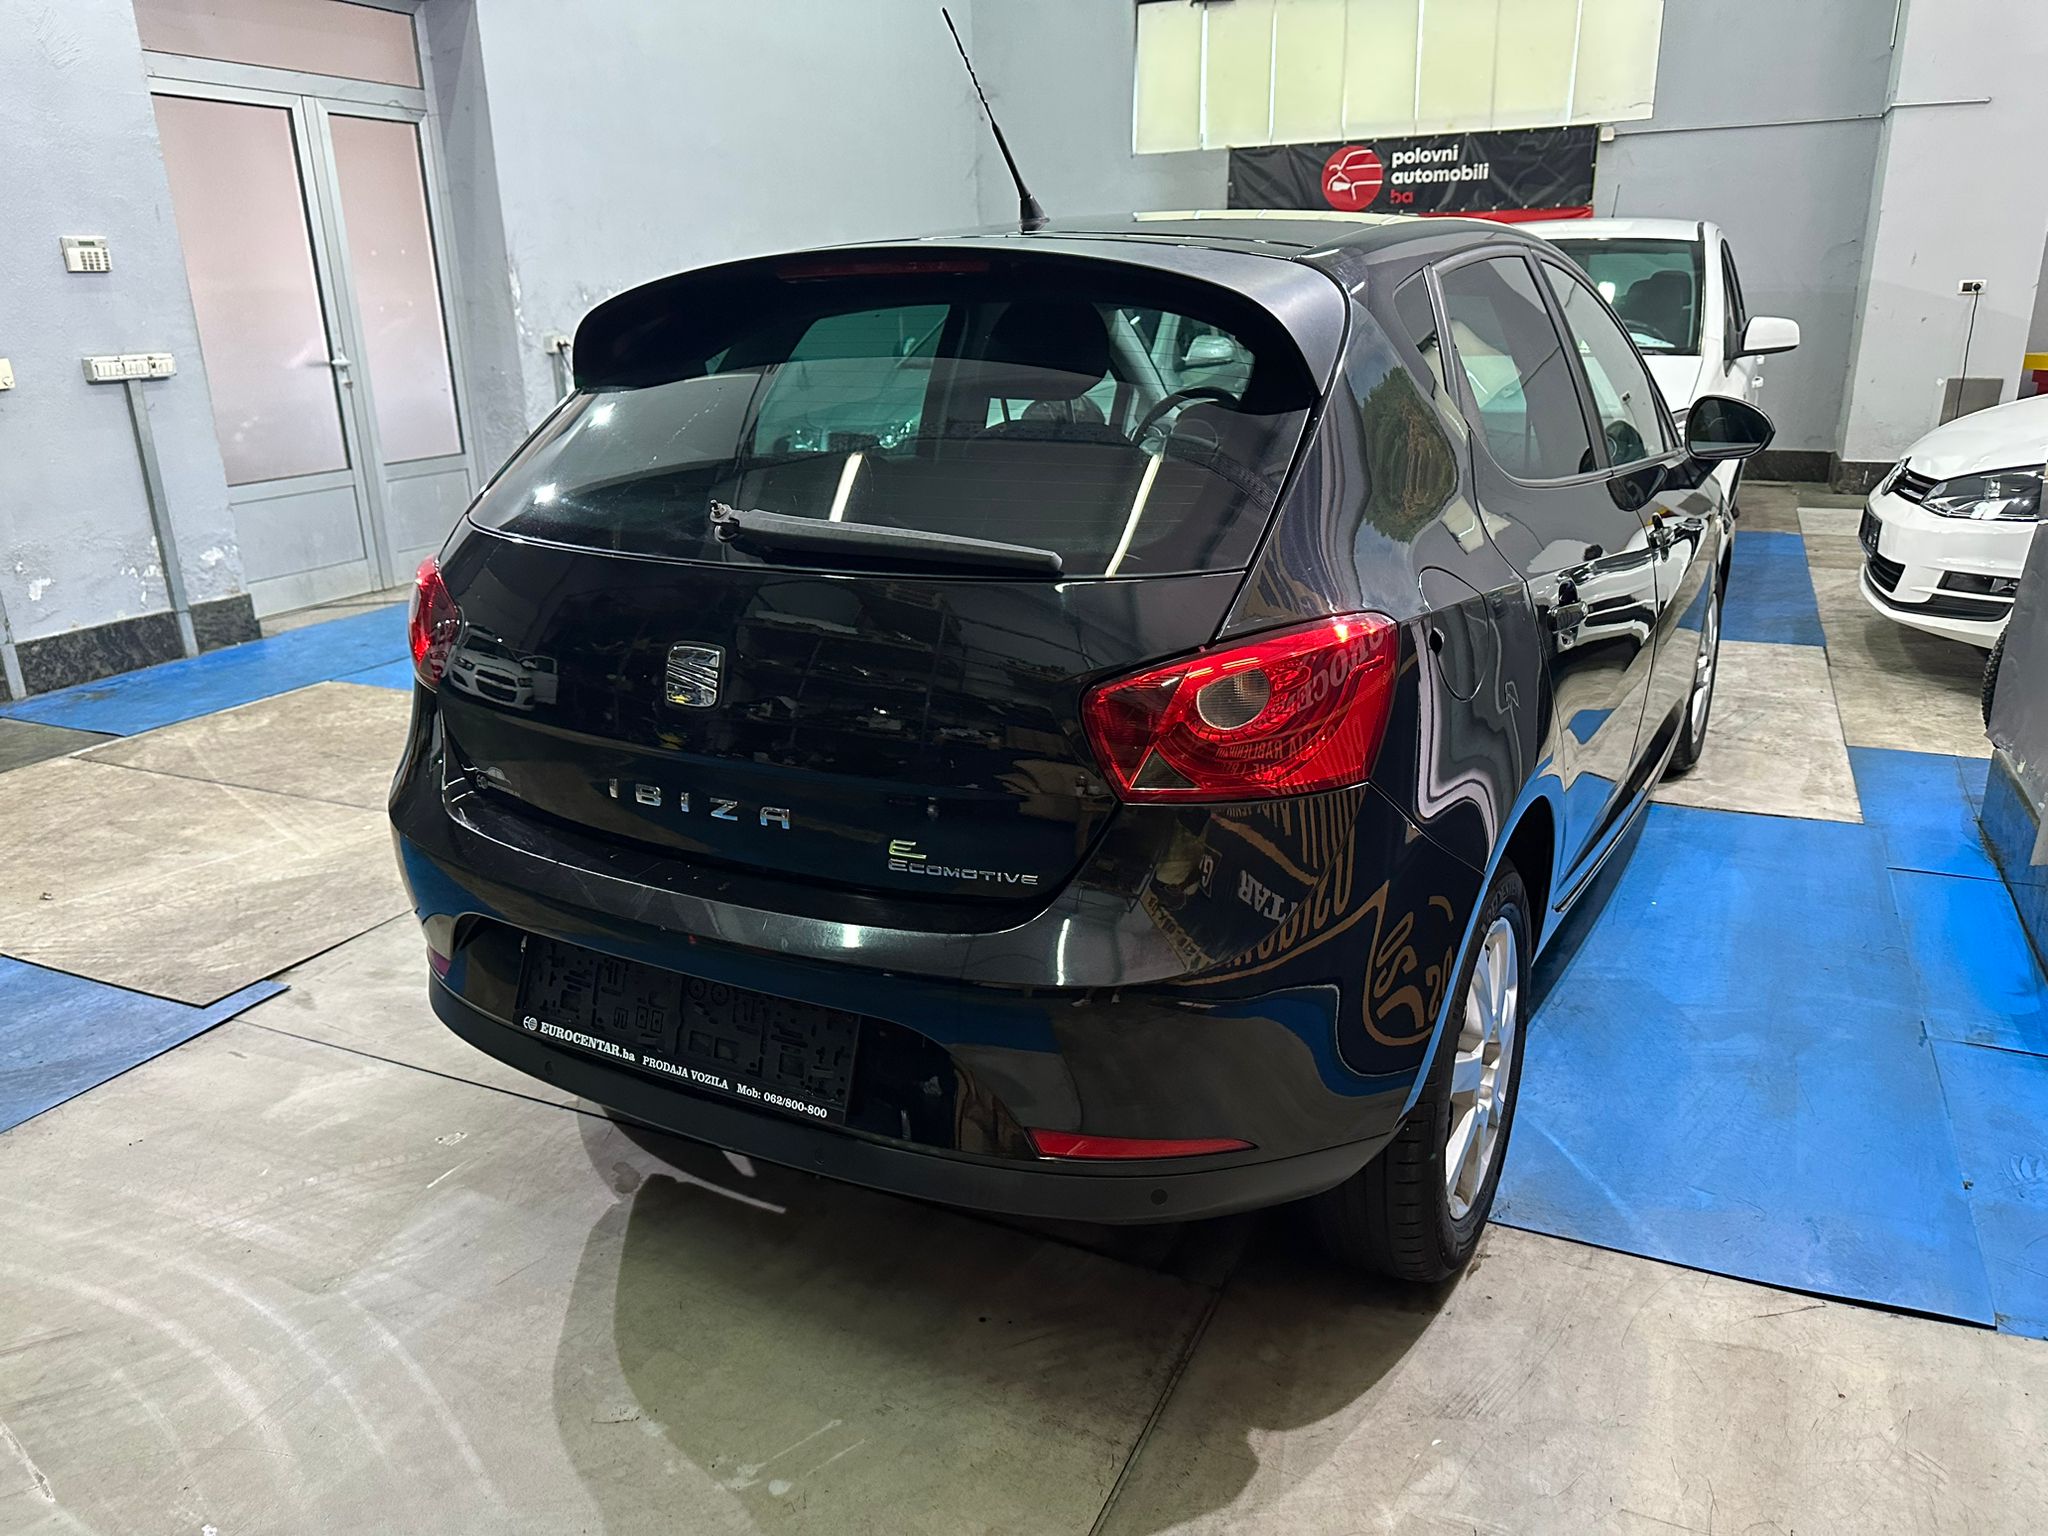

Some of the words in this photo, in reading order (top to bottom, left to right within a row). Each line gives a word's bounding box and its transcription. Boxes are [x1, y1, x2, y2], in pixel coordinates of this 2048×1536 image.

[1391, 144, 1459, 169] polovni
[1390, 162, 1490, 185] automobili
[608, 777, 791, 830] IBIZA
[887, 857, 1039, 886] ECOMOTIVE
[540, 1021, 636, 1061] EUROCENTAR.ba
[642, 1055, 688, 1078] PRODAJA
[691, 1069, 729, 1089] VOZILA
[736, 1083, 762, 1099] Mob:
[763, 1092, 828, 1118] 062/800-800
